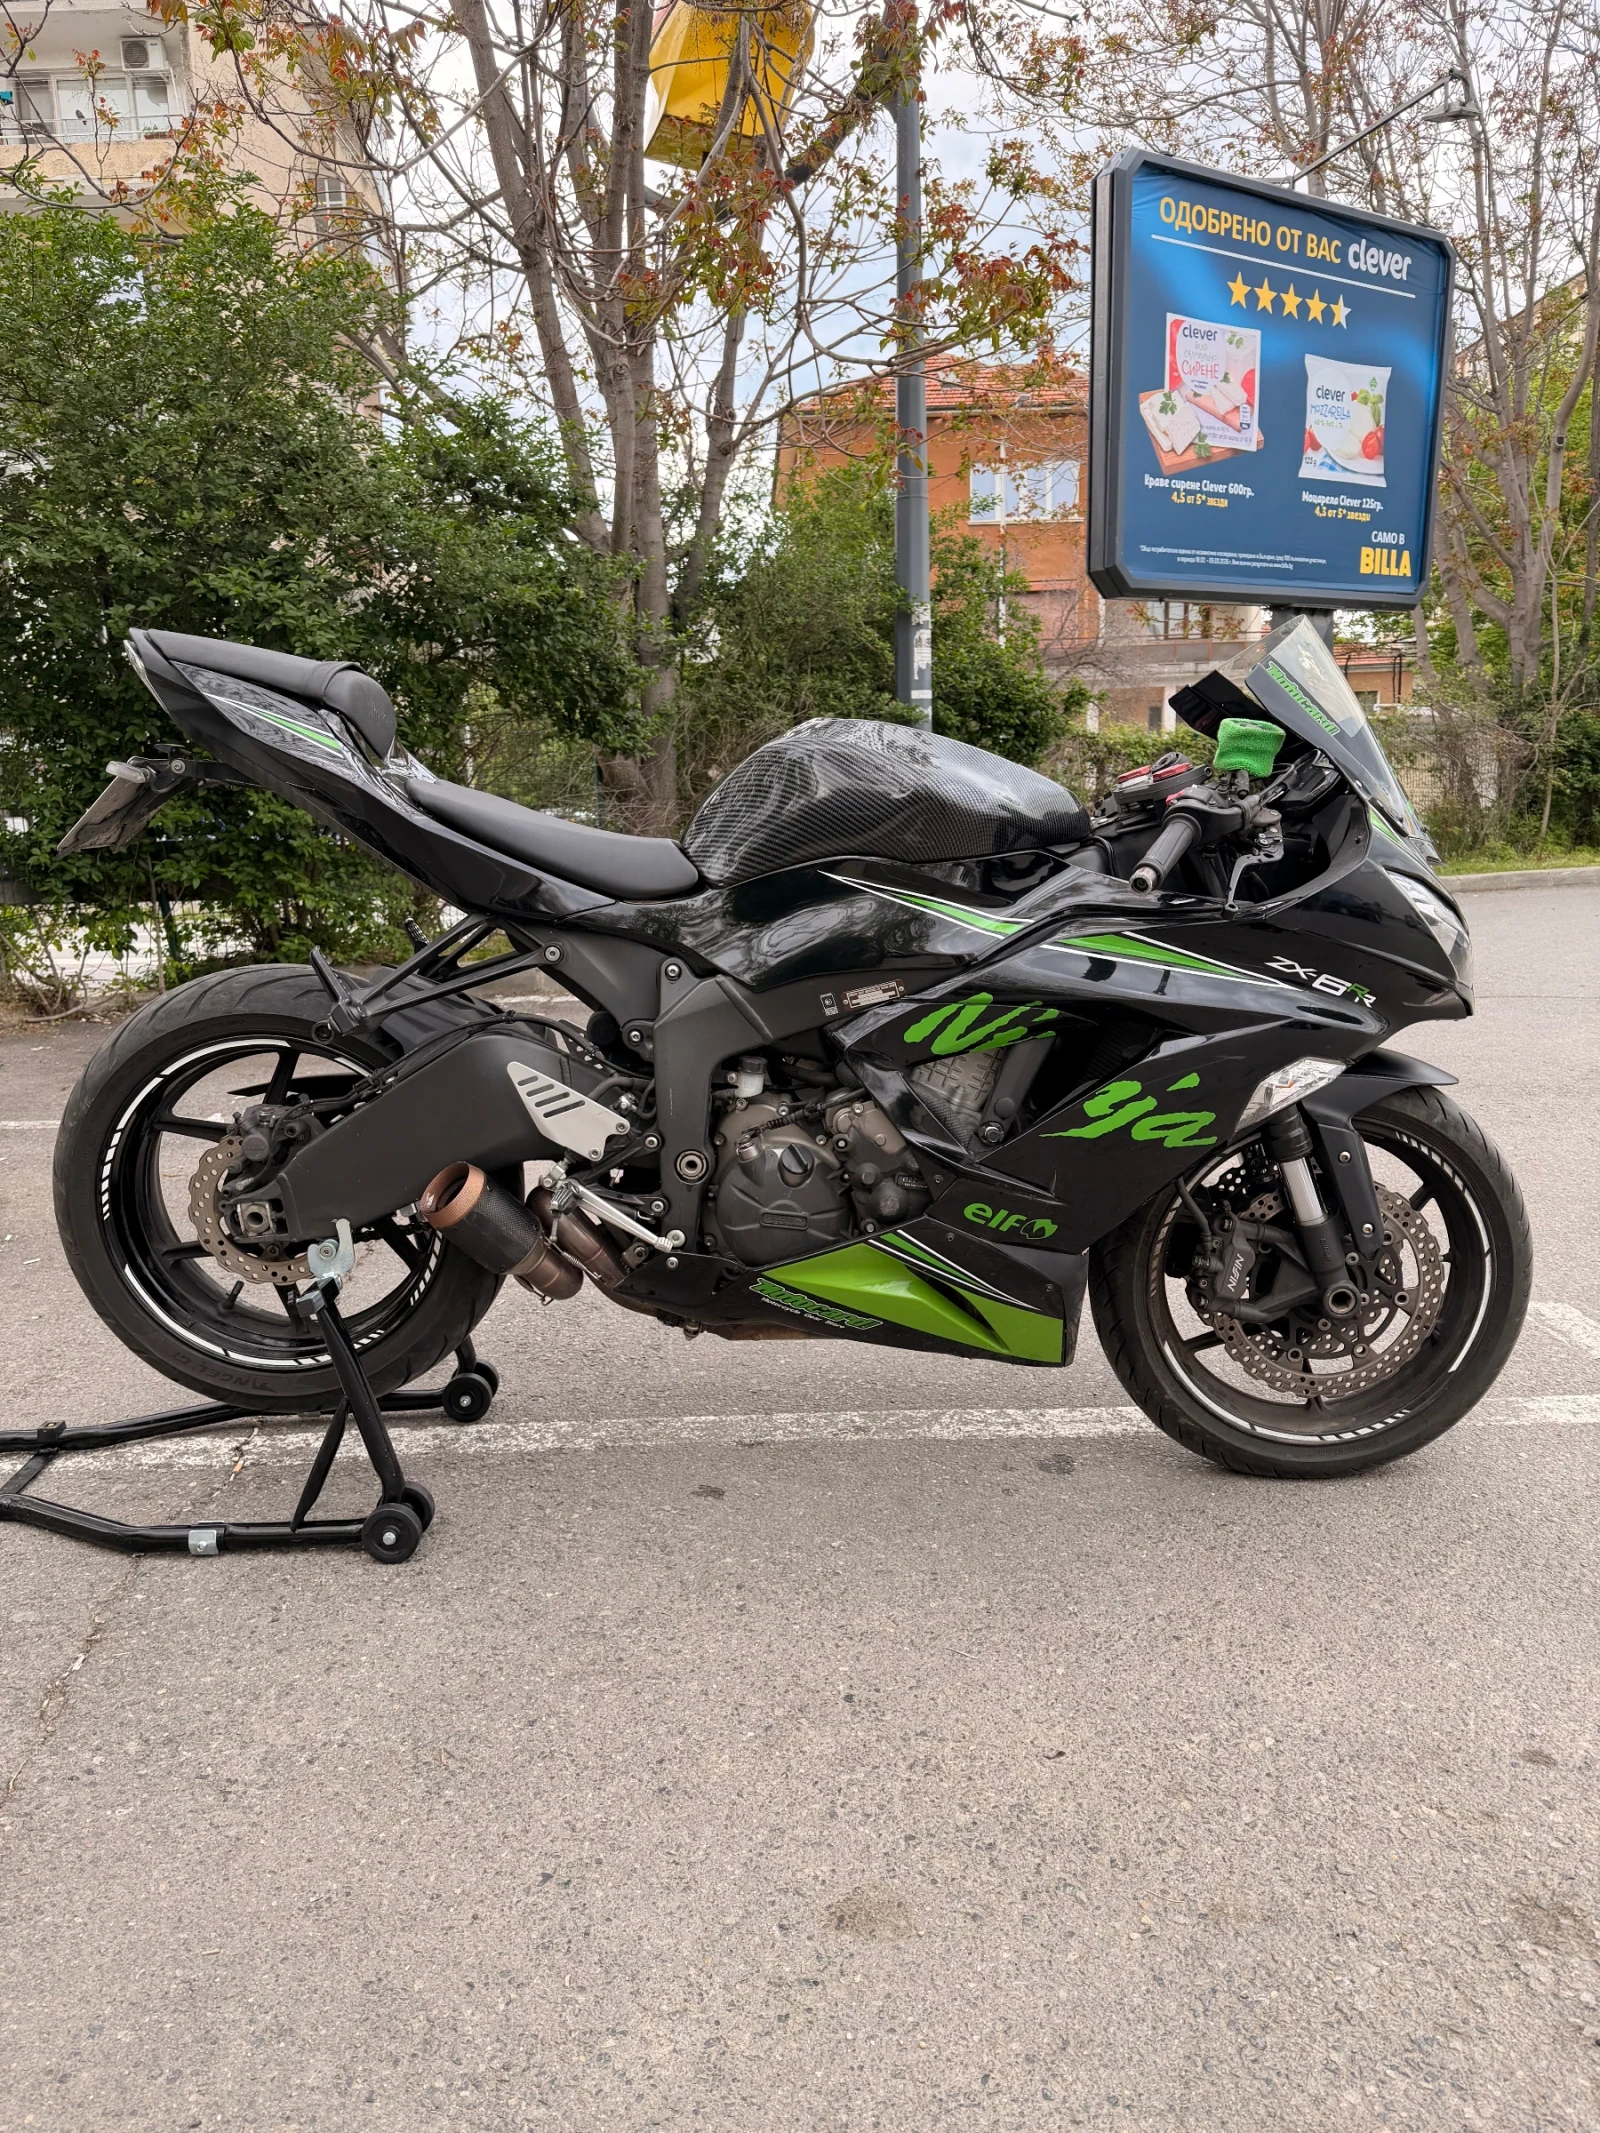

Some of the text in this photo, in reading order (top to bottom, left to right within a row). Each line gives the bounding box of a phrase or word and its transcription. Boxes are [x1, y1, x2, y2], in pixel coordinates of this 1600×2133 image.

[1160, 196, 1412, 281] ОДОБРЕНО ОТ ВАС clever
[1182, 324, 1219, 341] clever
[1316, 385, 1346, 402] clever
[1310, 404, 1351, 420] MOZZARELLA
[1144, 473, 1254, 498] Краве сирене Clever 600гр.
[1171, 491, 1186, 503] 4,5
[1186, 495, 1195, 504] от
[1302, 490, 1384, 512] Моцарела Clever 125гр.
[1314, 505, 1327, 517] 4,3
[1327, 509, 1337, 518] от
[1346, 511, 1371, 522] звезди
[1371, 530, 1405, 545] САМО В
[1360, 546, 1412, 577] BILLA
[963, 1203, 1028, 1232] elf
[1227, 1253, 1245, 1292] NISSIN
[749, 1278, 884, 1330] Motocard
[761, 1297, 801, 1315] Motorcycle
[825, 1320, 845, 1329] Store
